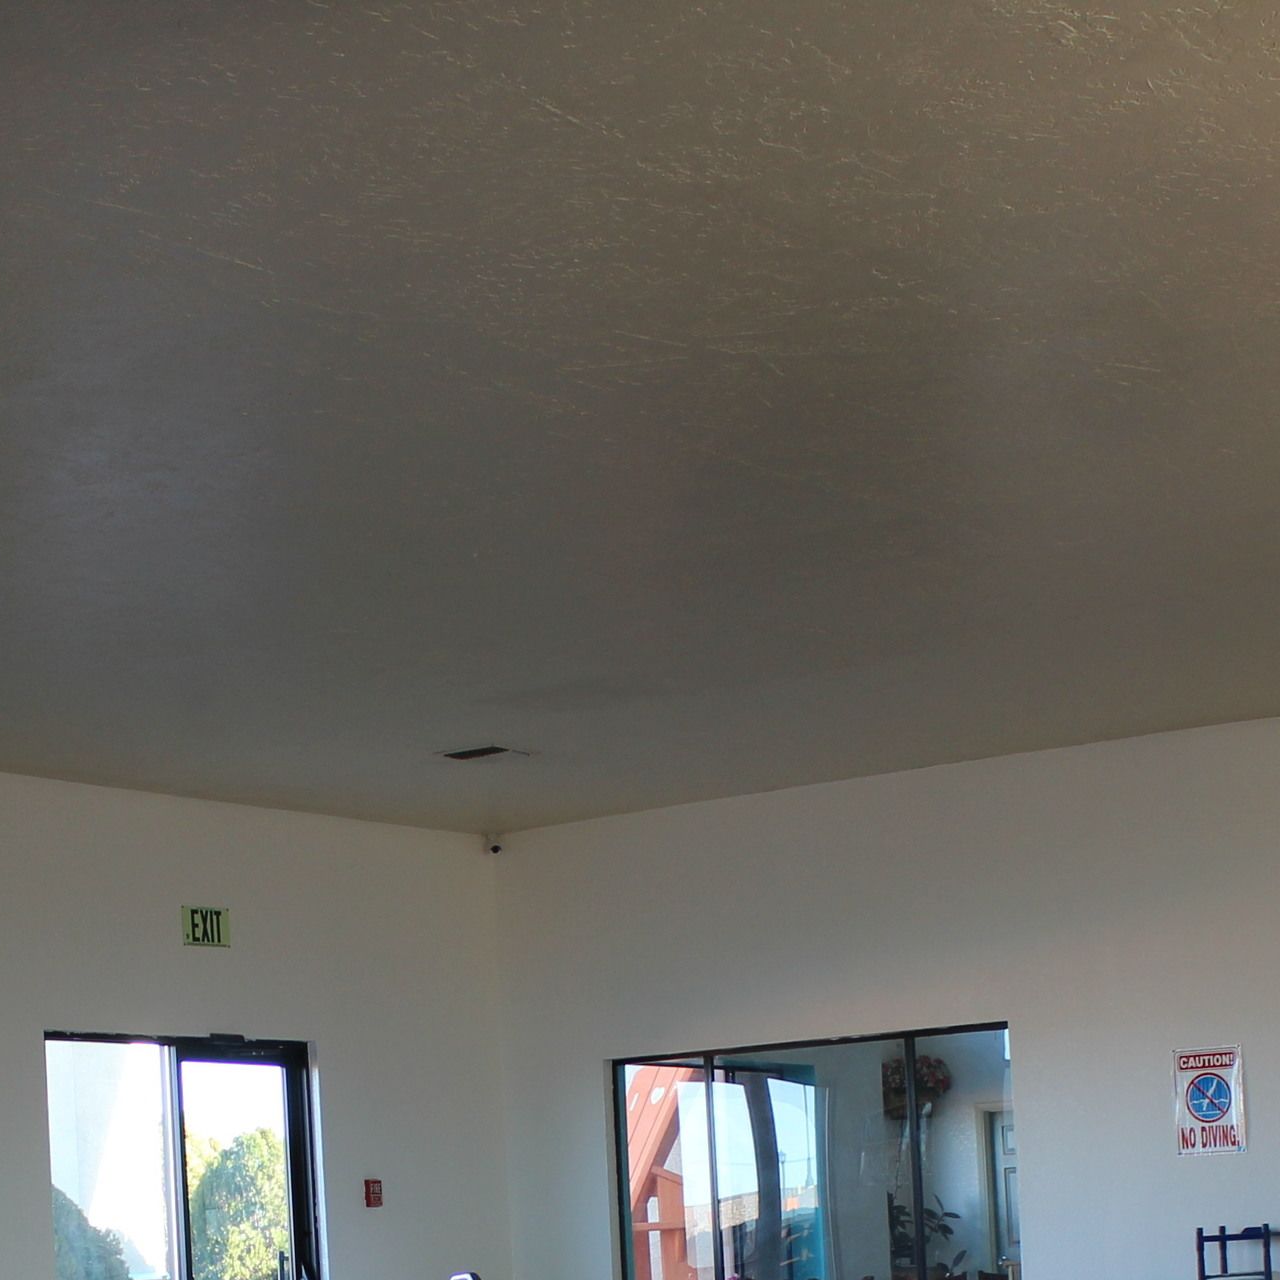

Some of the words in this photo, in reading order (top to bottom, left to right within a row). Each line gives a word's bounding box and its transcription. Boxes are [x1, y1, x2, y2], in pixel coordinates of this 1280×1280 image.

[191, 909, 222, 943] EXIT
[1180, 1054, 1233, 1068] CAUTION!
[1181, 1127, 1196, 1149] NO
